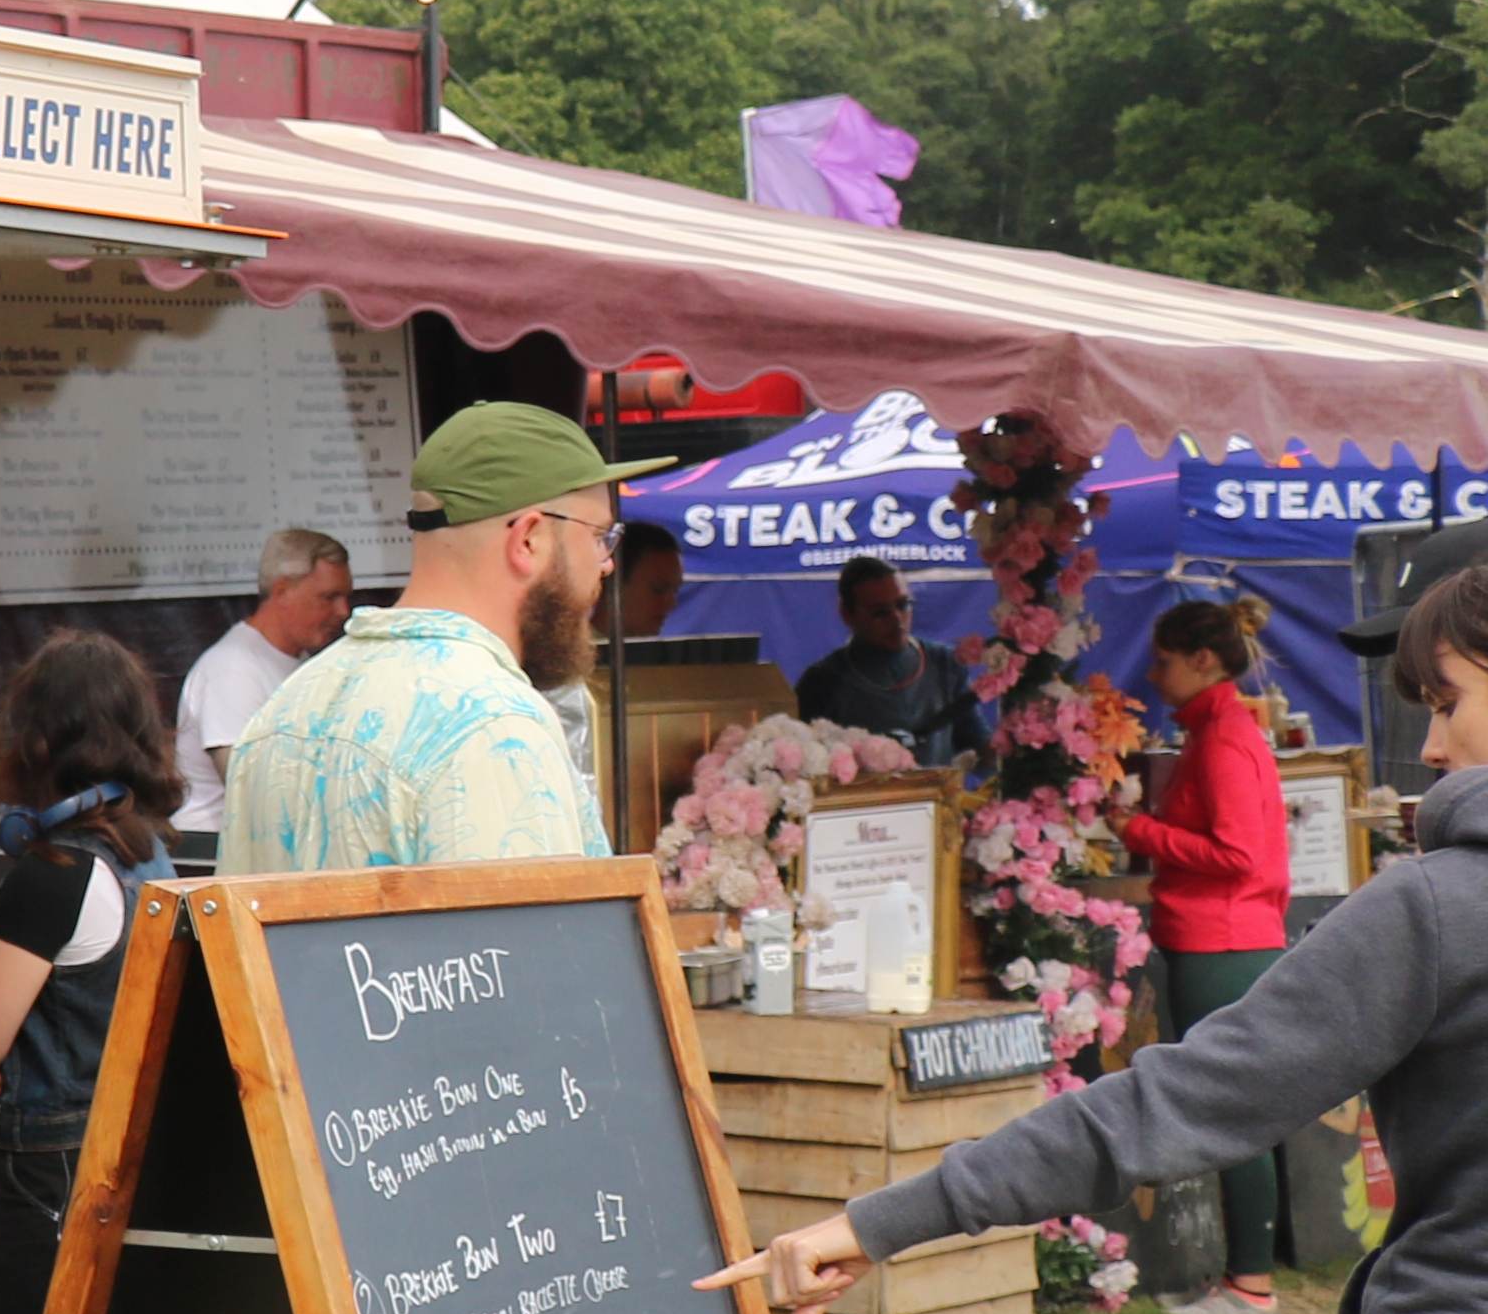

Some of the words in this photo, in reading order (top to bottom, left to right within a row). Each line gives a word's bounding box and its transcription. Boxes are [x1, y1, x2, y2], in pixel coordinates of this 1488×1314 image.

[92, 95, 174, 182] HERE
[683, 497, 858, 548] STEAK
[869, 493, 917, 539] &
[1214, 478, 1386, 521] STEAK
[1398, 478, 1434, 520] &
[343, 941, 511, 1042] BREAKFAST
[906, 1026, 956, 1083] HOT
[955, 1013, 1053, 1077] CHOCOLATE
[433, 1075, 478, 1116] BUN
[484, 1064, 525, 1101] ONE
[560, 1065, 588, 1120] £5
[400, 1144, 438, 1181] HASH
[488, 1126, 507, 1145] in
[506, 1120, 521, 1136] a
[515, 1108, 548, 1135] BUN
[455, 1234, 500, 1280] BUN
[505, 1212, 557, 1264] TWO
[593, 1189, 628, 1242] £7
[582, 1264, 630, 1303] CHEESE
